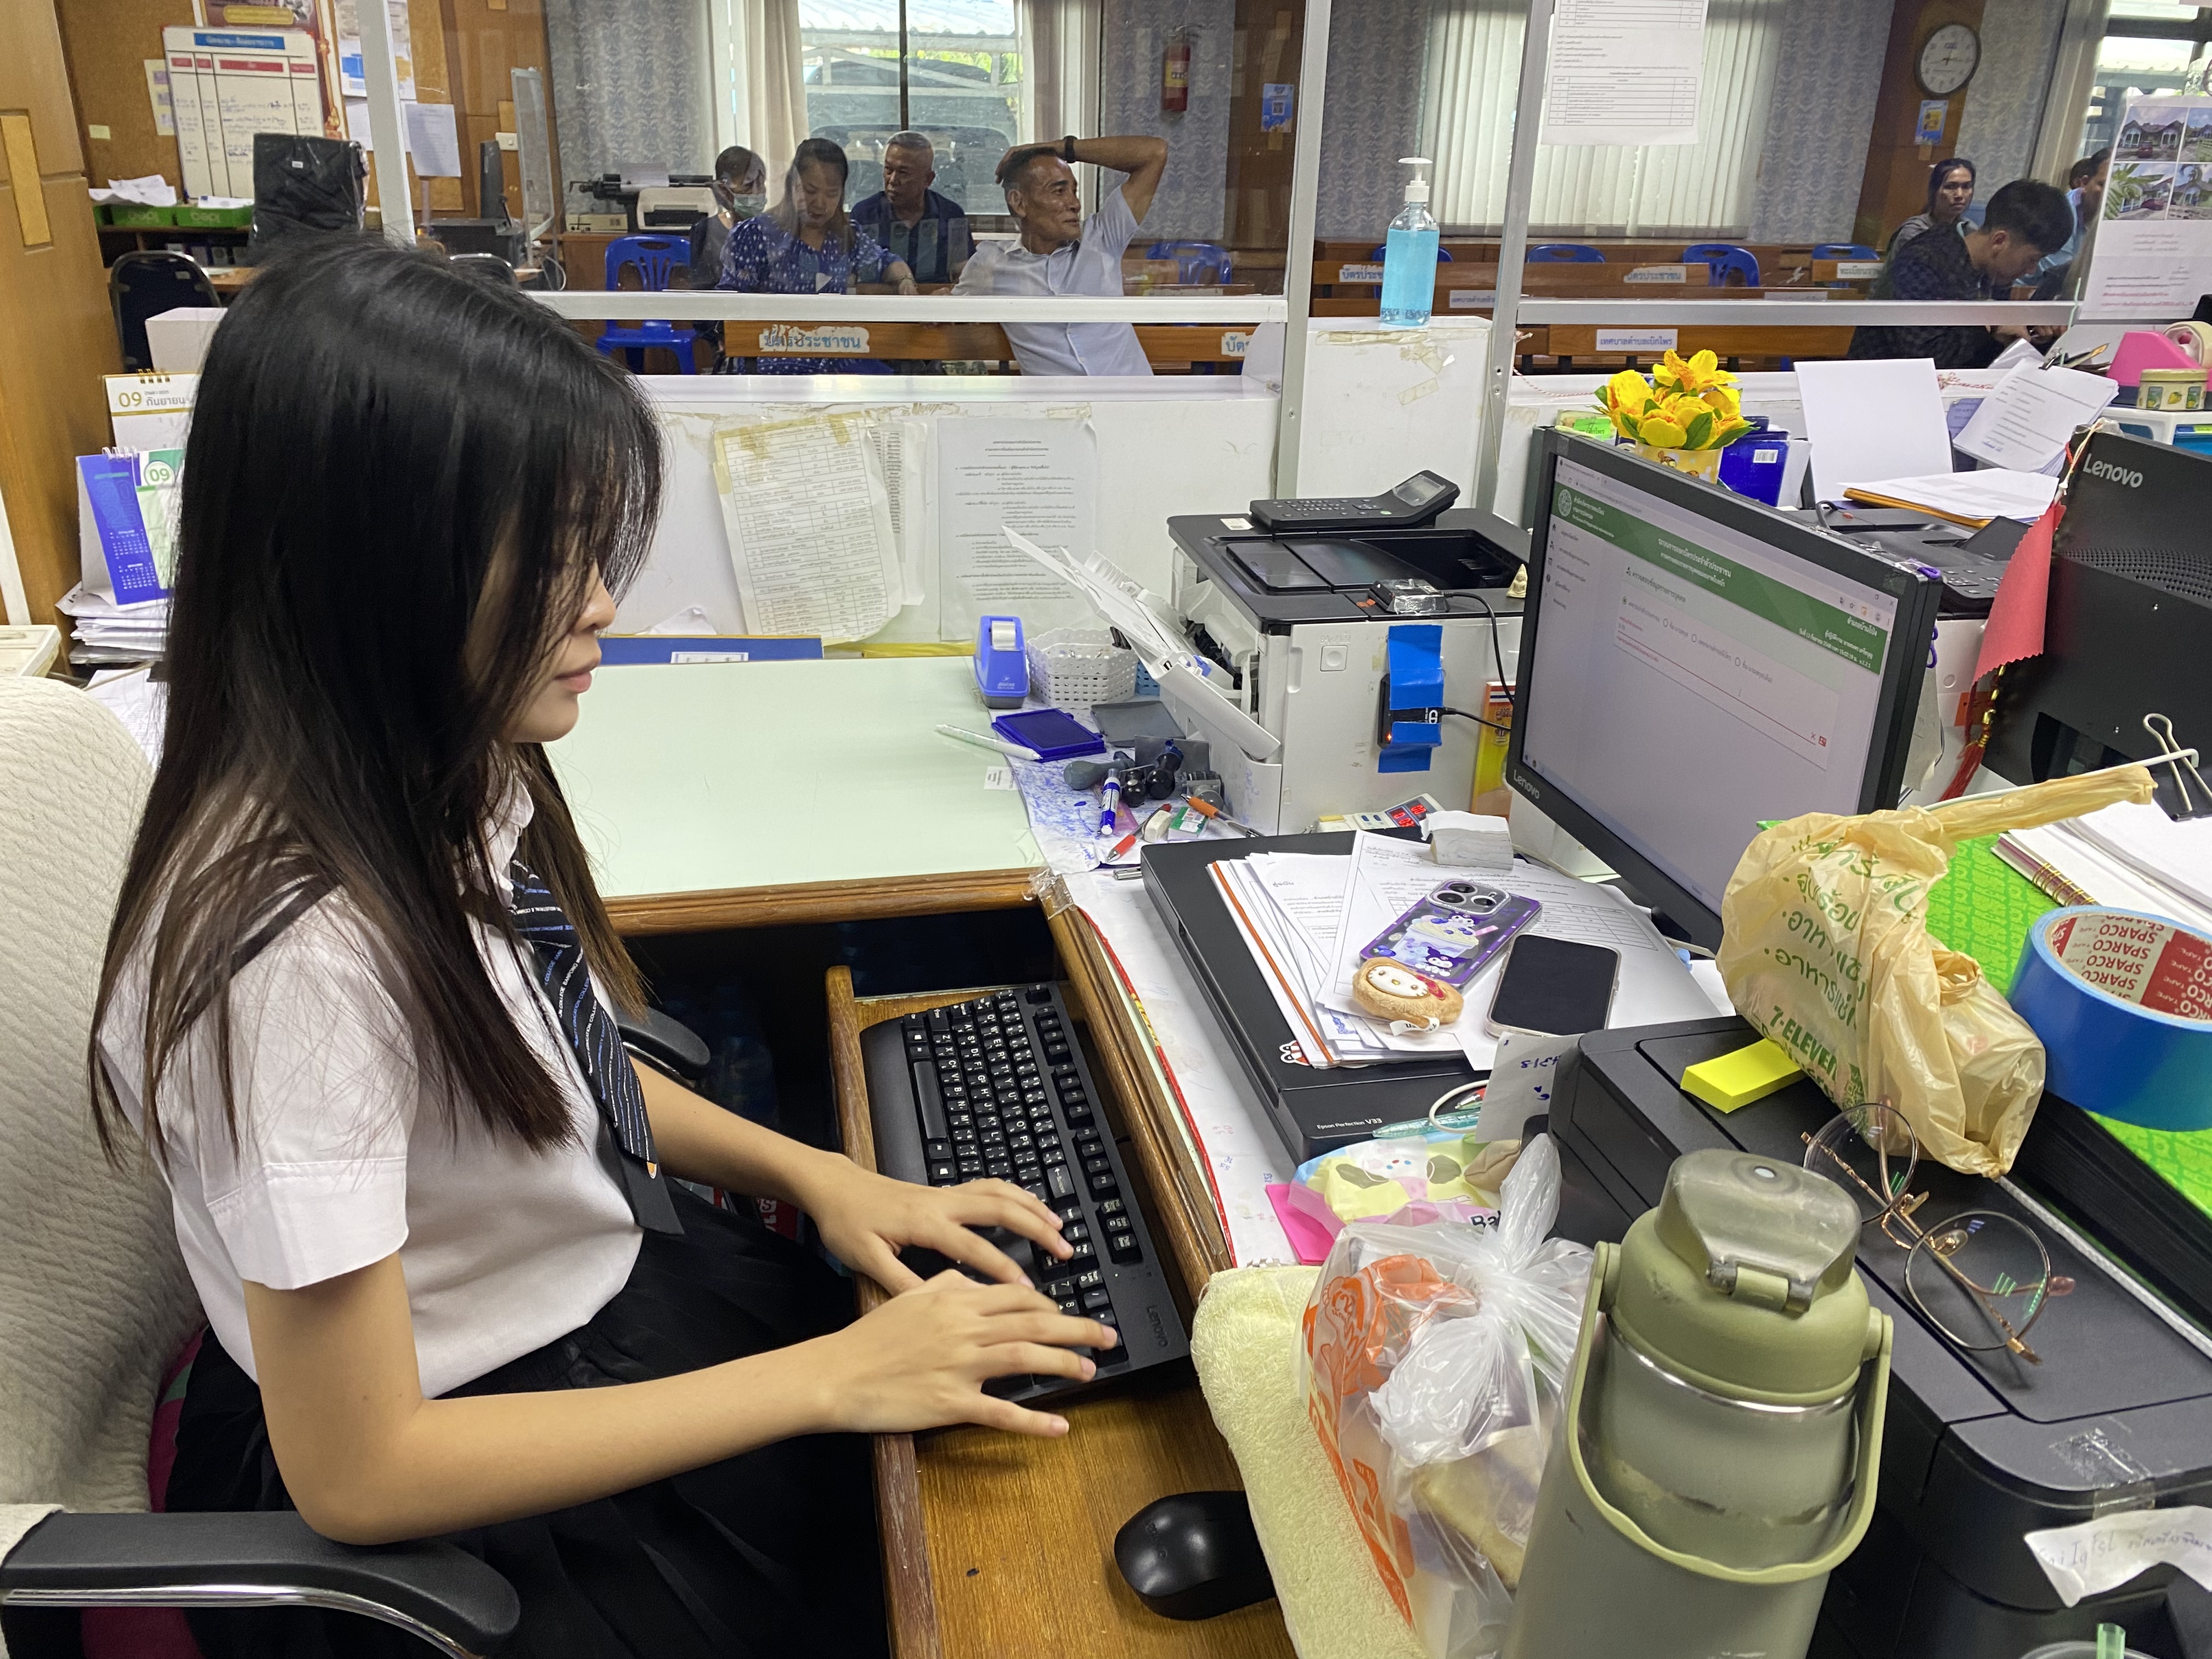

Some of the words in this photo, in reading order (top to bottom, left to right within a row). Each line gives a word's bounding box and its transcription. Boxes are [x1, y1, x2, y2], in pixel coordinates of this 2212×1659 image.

[119, 391, 143, 408] 09
[149, 467, 171, 483] 09
[2083, 453, 2143, 488] Lenovo
[1513, 768, 1541, 800] Lenovo
[2100, 924, 2158, 944] SPARCO
[2093, 940, 2151, 960] SPARCO
[2086, 955, 2145, 975] SPARCO
[2171, 960, 2192, 973] TAPE
[2163, 976, 2185, 989] TAPE
[2157, 991, 2178, 1005] TAPE
[1147, 1305, 1169, 1347] Lenovo
